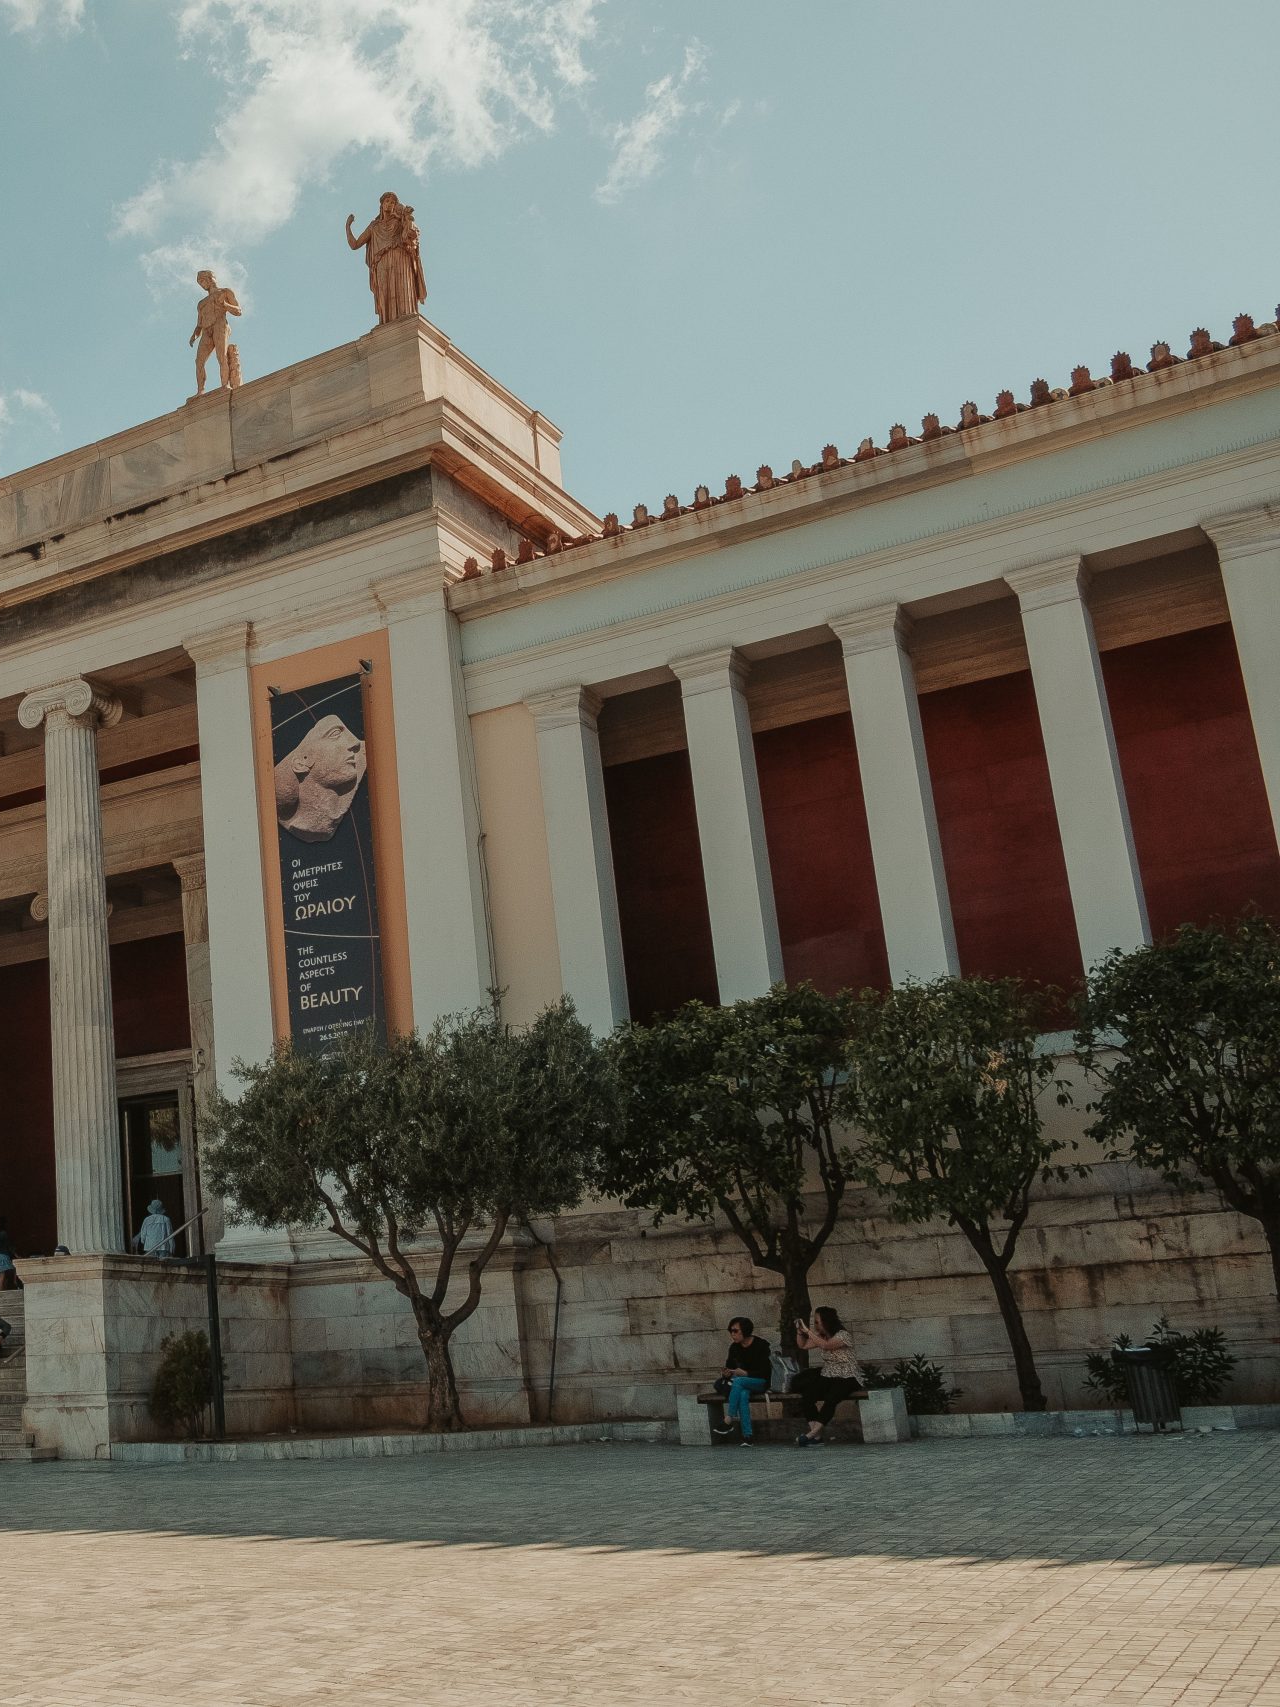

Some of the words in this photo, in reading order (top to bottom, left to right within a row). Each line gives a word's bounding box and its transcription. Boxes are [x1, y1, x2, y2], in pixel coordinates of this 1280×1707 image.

[292, 859, 300, 868] ΟΙ
[292, 862, 343, 879] ΑΜΕΤΡΗΤΕΣ
[293, 879, 318, 891] ΟΨΕΙΣ
[294, 892, 310, 902] ΤΟΥ
[296, 896, 356, 920] ΩΡΑΙΟΥ
[297, 946, 314, 956] THE
[298, 952, 347, 968] COUNTLESS
[300, 966, 335, 980] ASPECTS
[300, 983, 312, 992] OF
[300, 986, 362, 1009] BEAUTY
